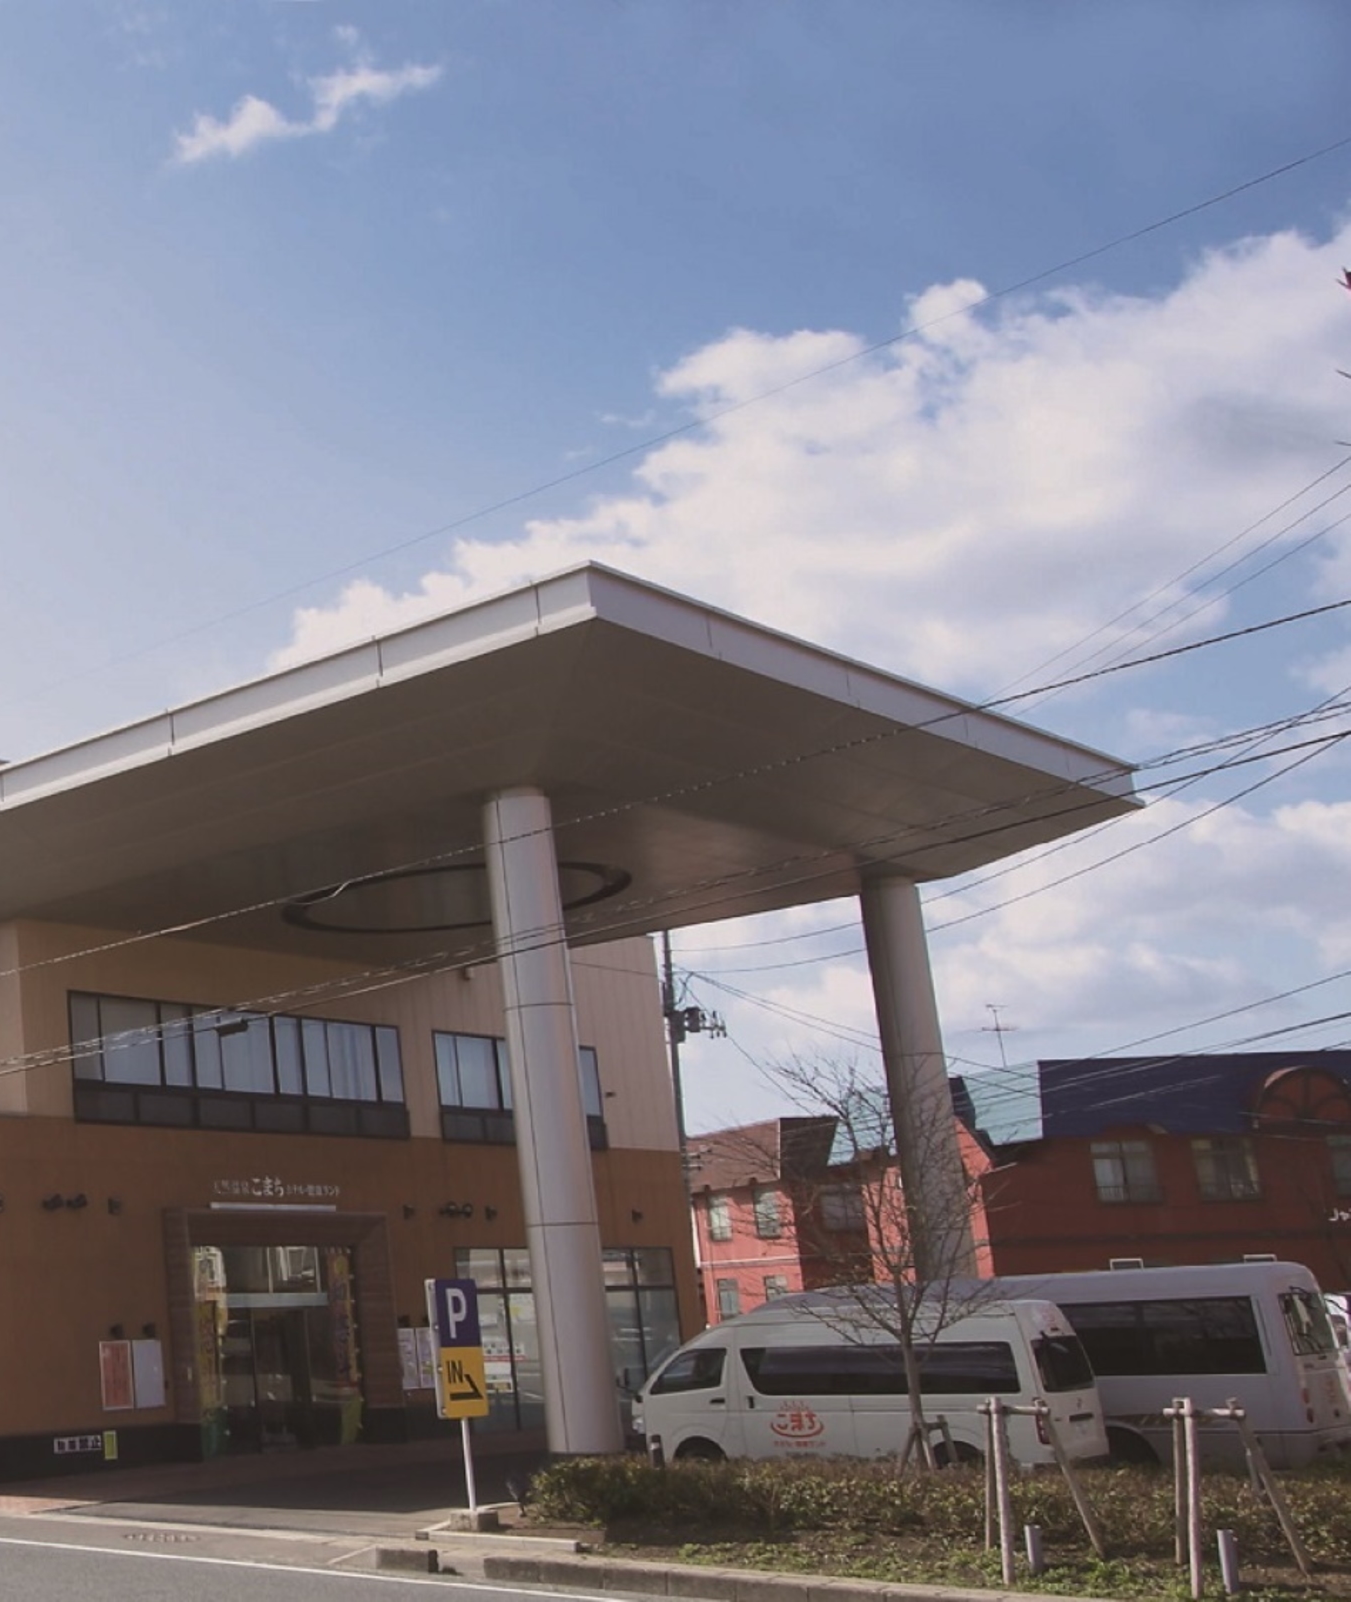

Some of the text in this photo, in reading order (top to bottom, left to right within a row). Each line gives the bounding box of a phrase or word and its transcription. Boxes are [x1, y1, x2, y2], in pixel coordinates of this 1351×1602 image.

[445, 1288, 467, 1339] P
[446, 1360, 464, 1384] IN
[777, 1410, 818, 1431] こまち
